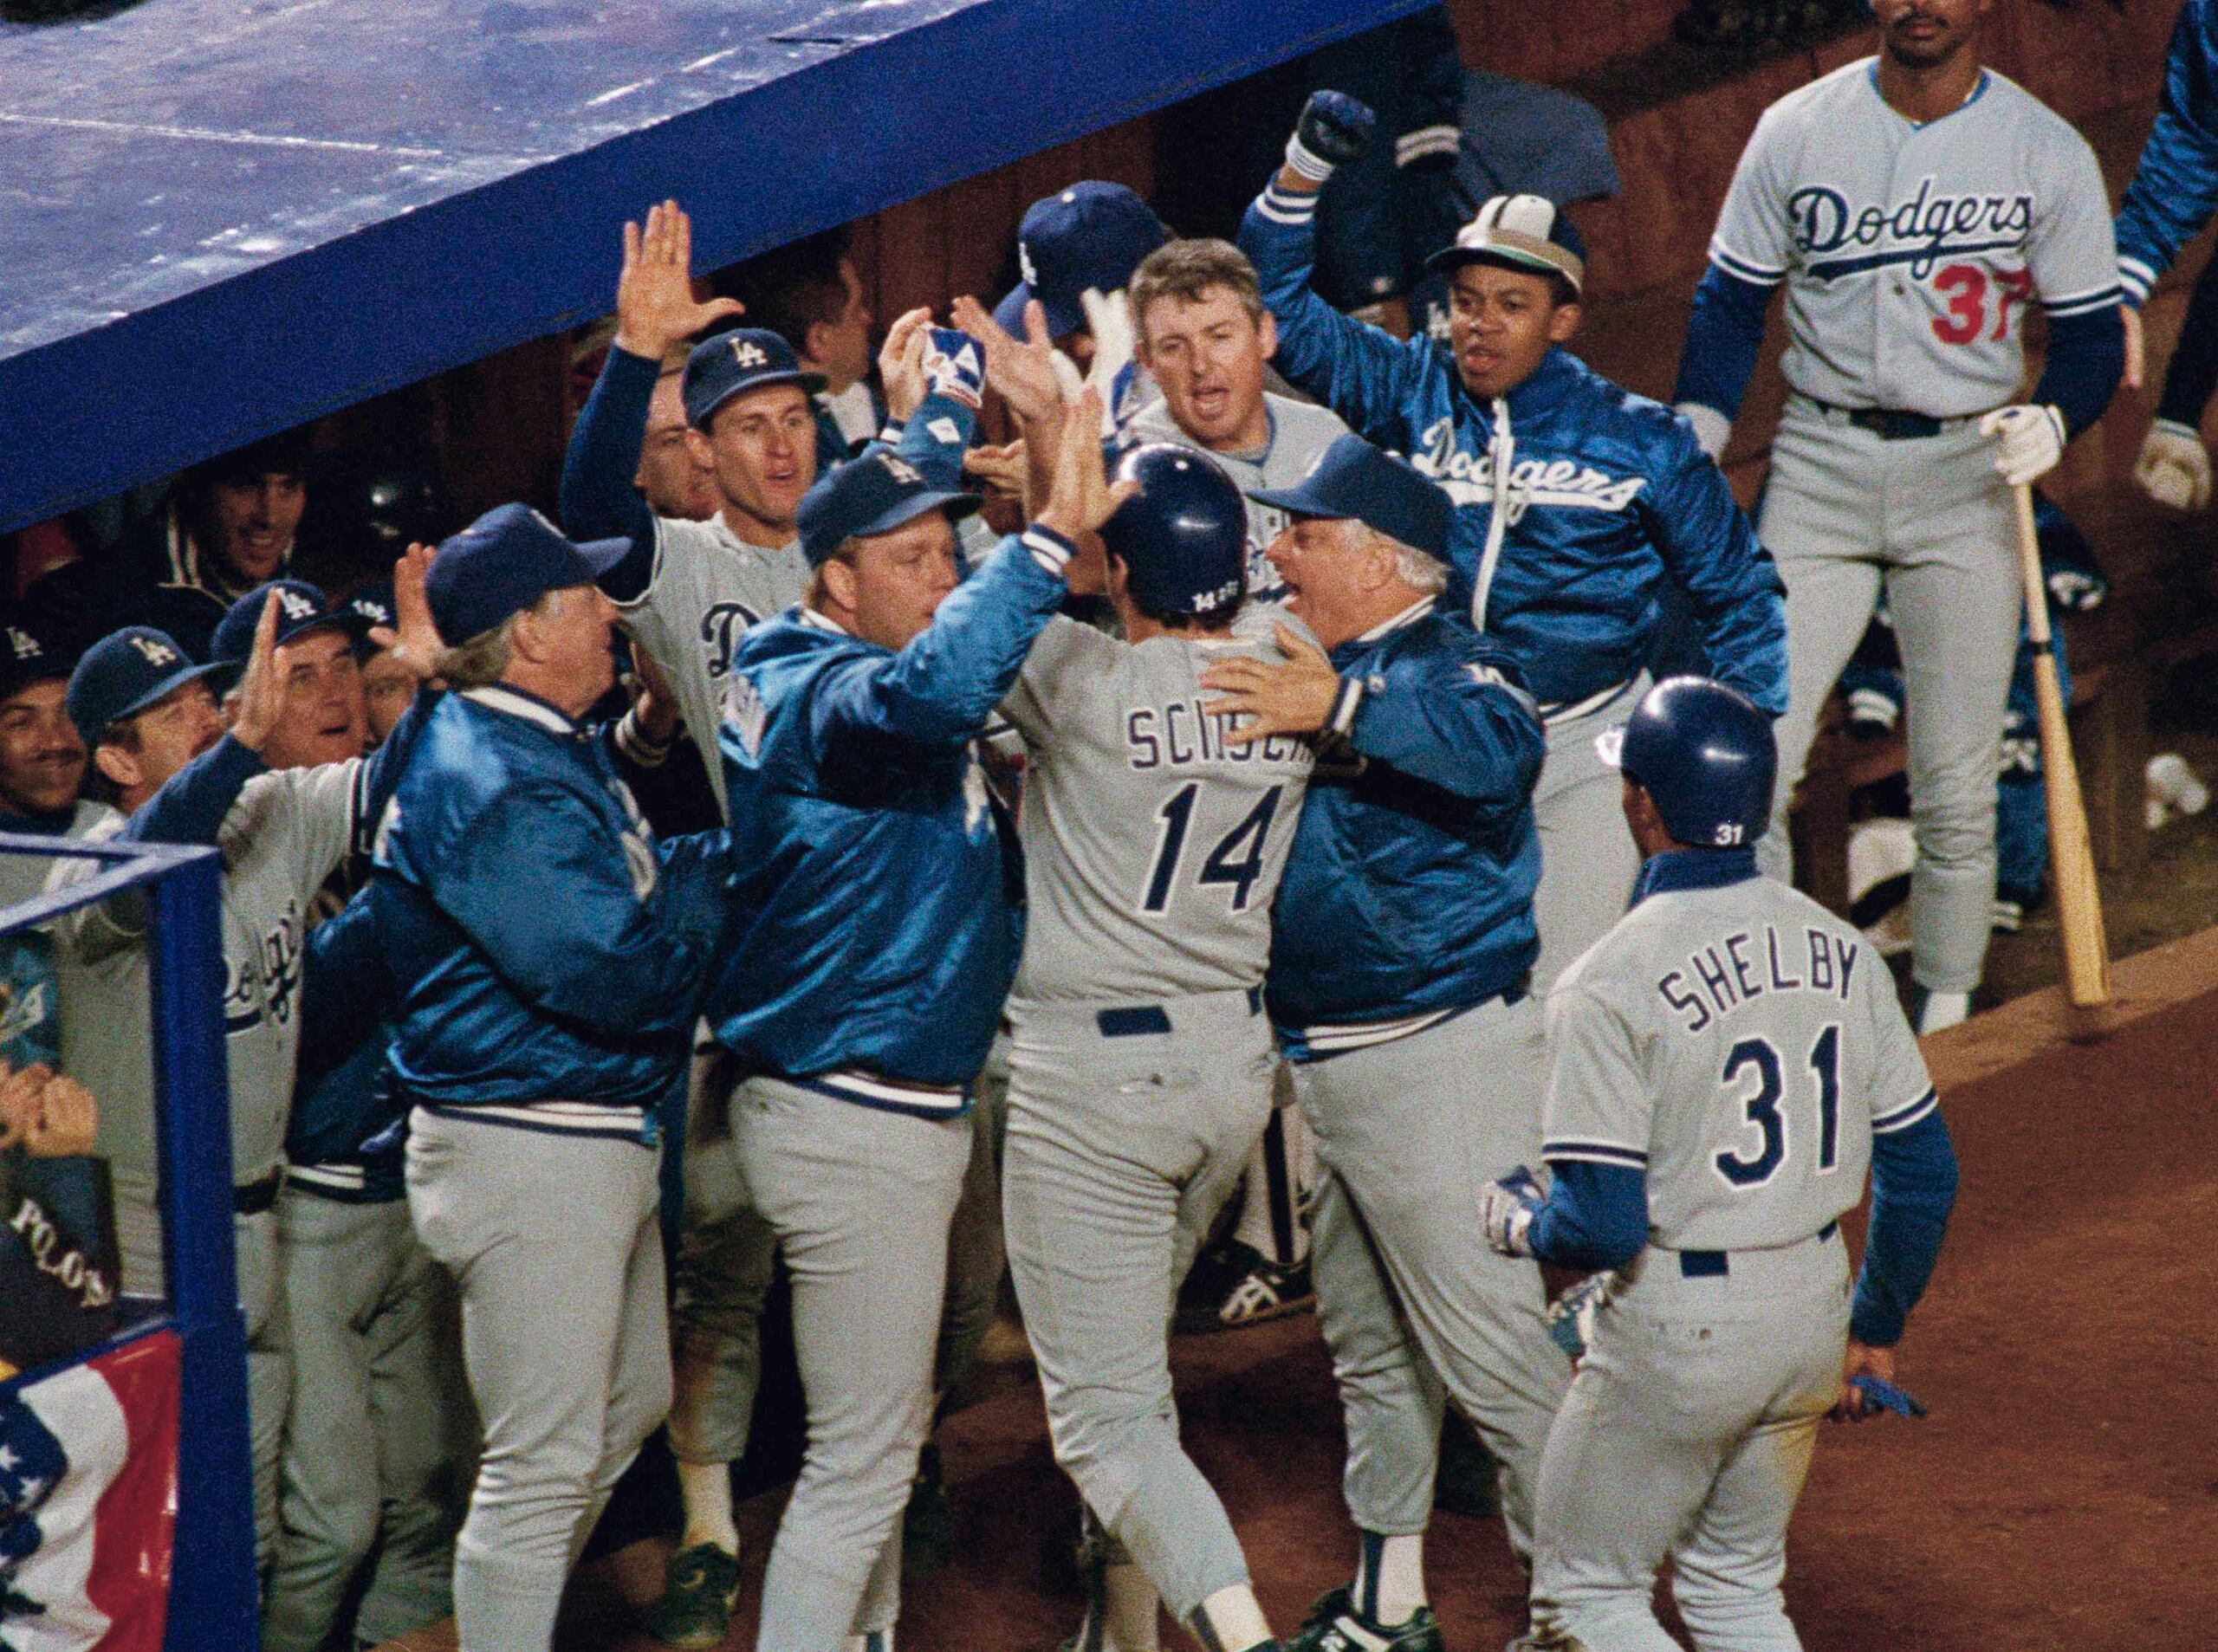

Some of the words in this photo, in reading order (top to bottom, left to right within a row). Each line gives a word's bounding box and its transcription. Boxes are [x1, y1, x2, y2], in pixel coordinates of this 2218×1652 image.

[1787, 178, 2032, 281] Dodgers
[1931, 264, 2033, 346] 37
[729, 336, 769, 368] LA
[276, 587, 317, 619] LA
[4, 626, 43, 660] LA
[130, 637, 178, 666] LA
[1141, 782, 1284, 912] 14
[1715, 824, 1743, 845] 31
[1657, 926, 1858, 1032] SHELBY
[1715, 1026, 1839, 1186] 31
